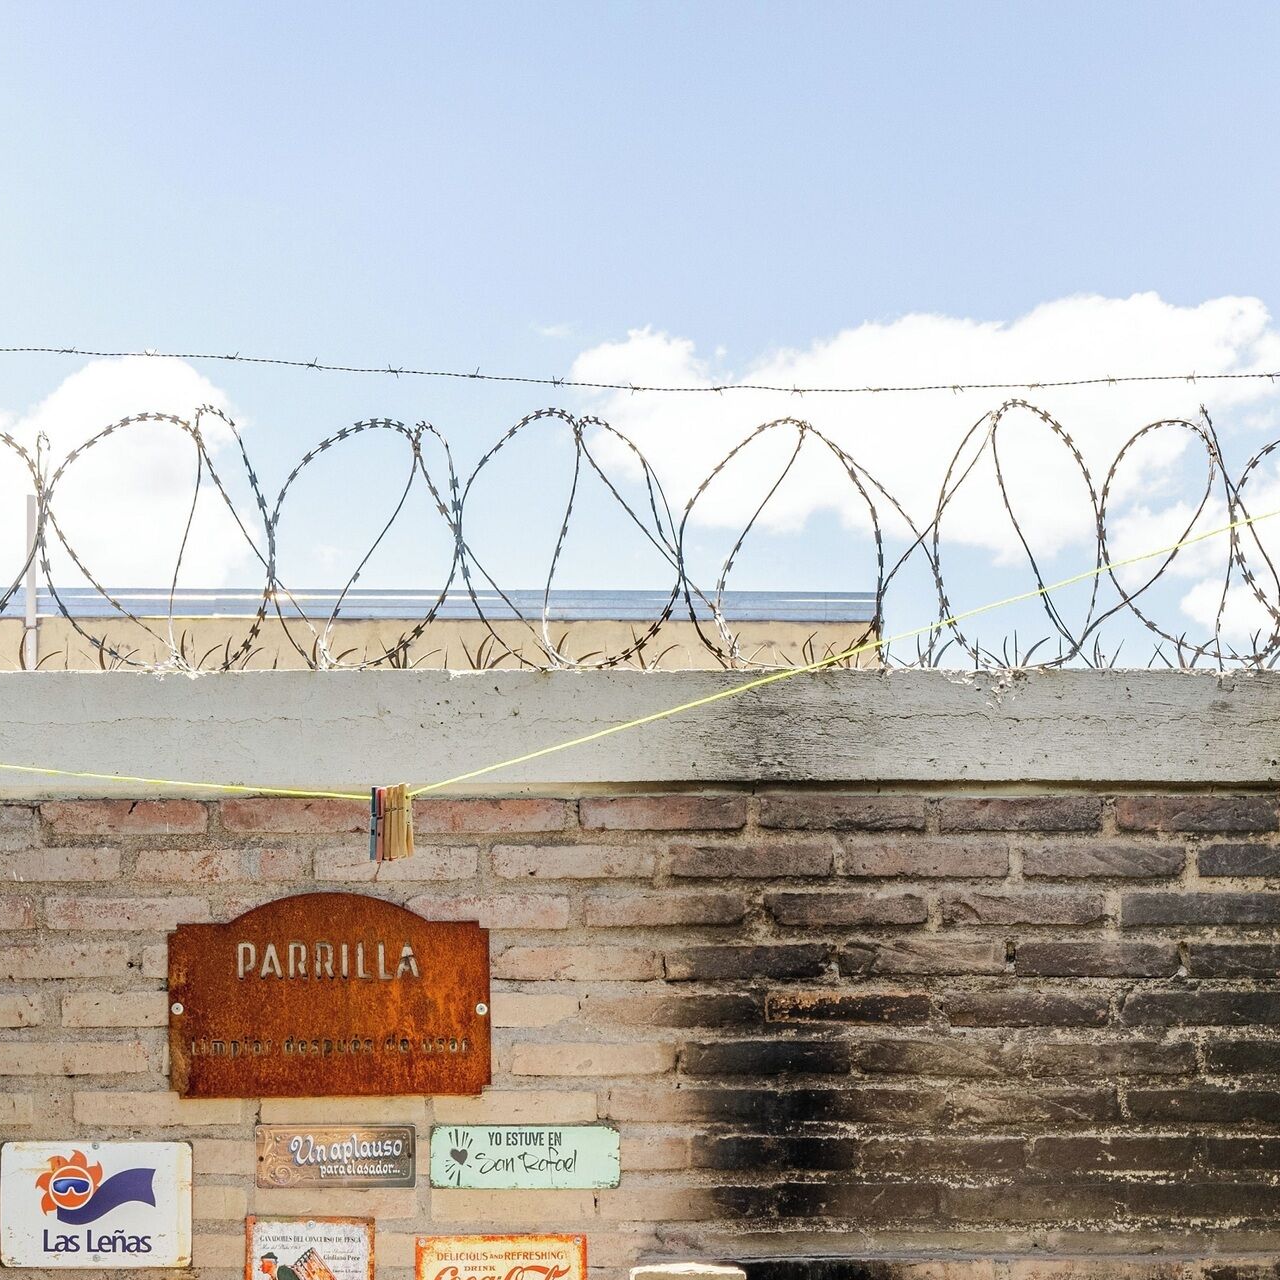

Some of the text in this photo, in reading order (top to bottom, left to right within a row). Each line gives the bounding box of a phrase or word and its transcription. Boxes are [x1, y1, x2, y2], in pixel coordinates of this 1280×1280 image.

[237, 941, 420, 980] PARRILLA
[284, 1033, 373, 1058] después
[385, 1034, 410, 1051] de
[422, 1036, 469, 1052] usar
[290, 1133, 403, 1165] Un aplauso
[487, 1131, 562, 1147] YO ESTUVE EN
[319, 1164, 345, 1178] para
[347, 1160, 355, 1175] el
[474, 1146, 578, 1184] San Rafael
[43, 1229, 153, 1253] Las Leñas
[260, 1235, 362, 1244] GANADORES DEL CONCURSO DE PESCA
[436, 1251, 489, 1261] DELICIOUS
[504, 1251, 565, 1261] REFRESHING
